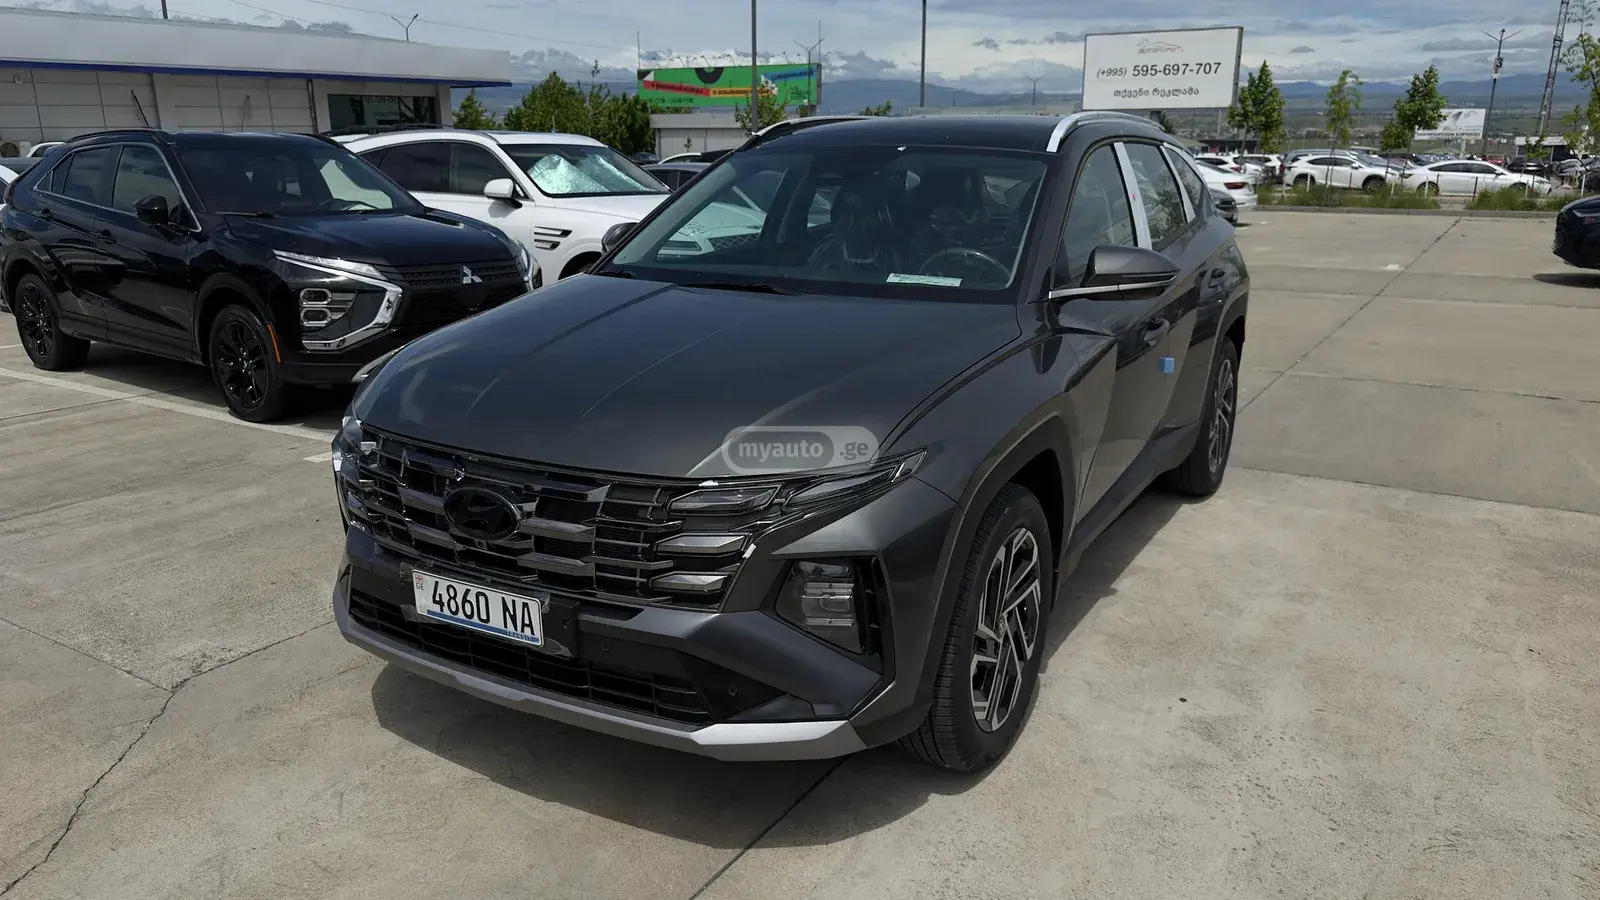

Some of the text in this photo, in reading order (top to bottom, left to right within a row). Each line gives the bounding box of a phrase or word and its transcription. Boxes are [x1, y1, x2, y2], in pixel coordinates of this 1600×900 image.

[1096, 62, 1222, 79] (+995) 595-697-707
[1113, 86, 1200, 98] თქვენი რეკლამა
[415, 582, 424, 591] GE
[431, 580, 536, 636] 4860 NA
